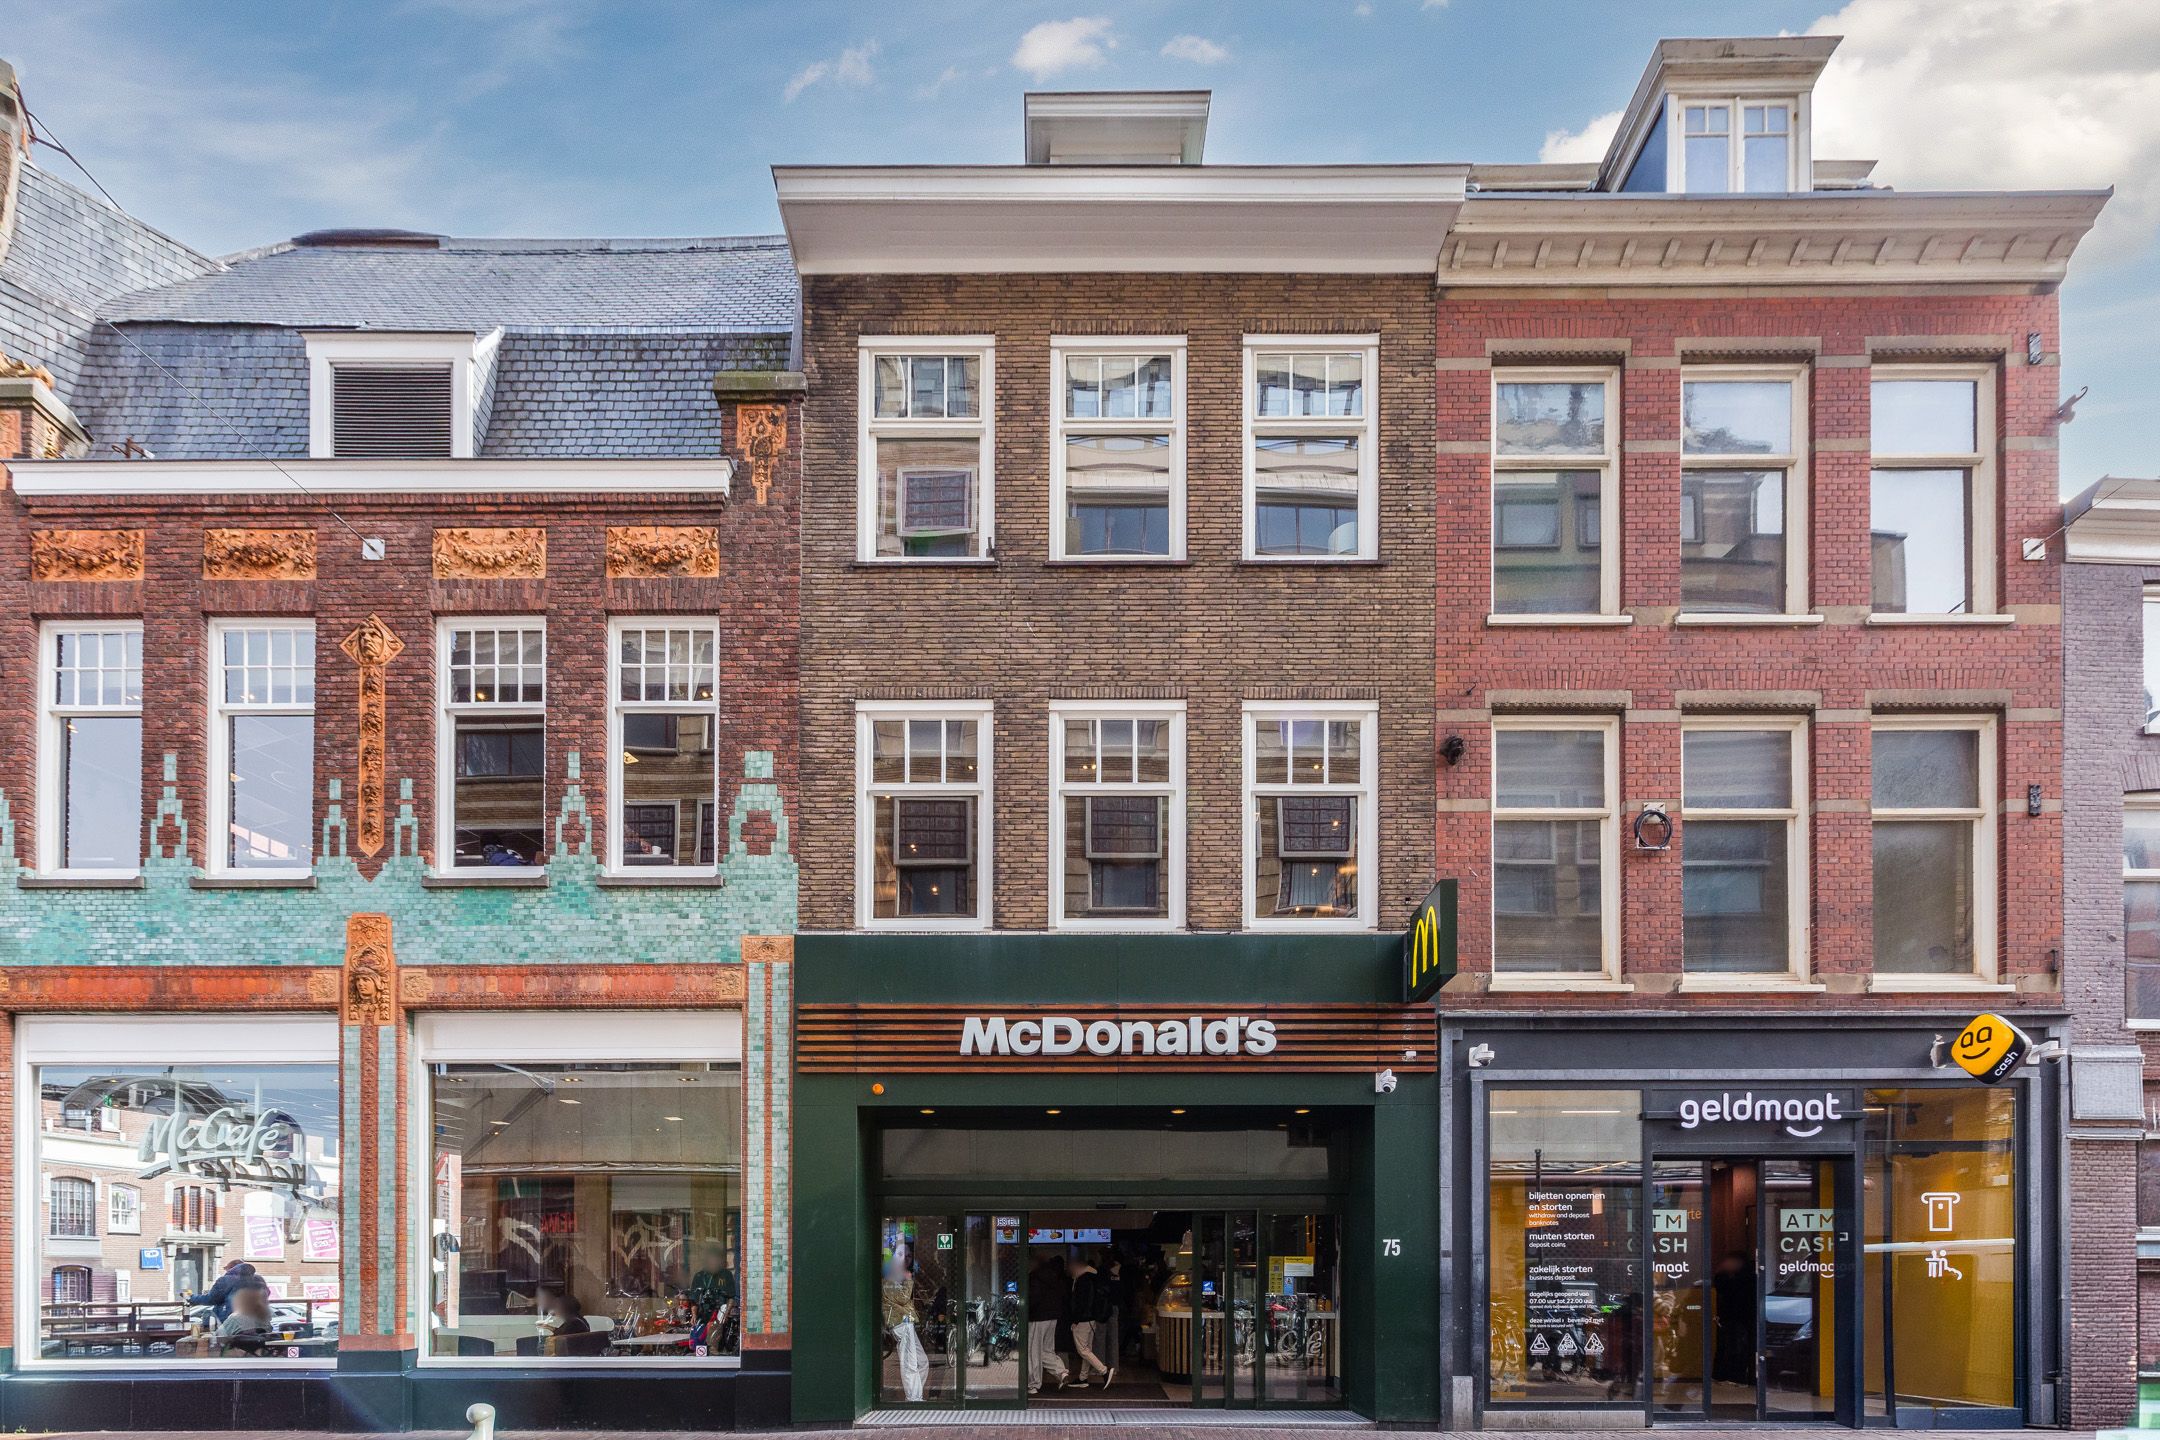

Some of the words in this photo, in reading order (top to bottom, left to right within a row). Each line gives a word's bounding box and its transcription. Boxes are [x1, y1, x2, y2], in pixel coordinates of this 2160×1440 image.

[959, 1016, 1277, 1055] McDonald's
[1994, 1051, 2019, 1077] cash
[1679, 1091, 1842, 1129] geldmaat
[1528, 1192, 1564, 1201] biljetten
[1565, 1193, 1606, 1201] opnemen
[1541, 1203, 1573, 1211] storten
[1653, 1214, 1682, 1229] TM
[1786, 1214, 1834, 1229] ATM
[1382, 1239, 1400, 1256] 75
[1528, 1265, 1560, 1275] zakelijk
[1561, 1265, 1593, 1273] storten
[1779, 1260, 1834, 1275] geldmaa
[1554, 1291, 1578, 1299] geopend
